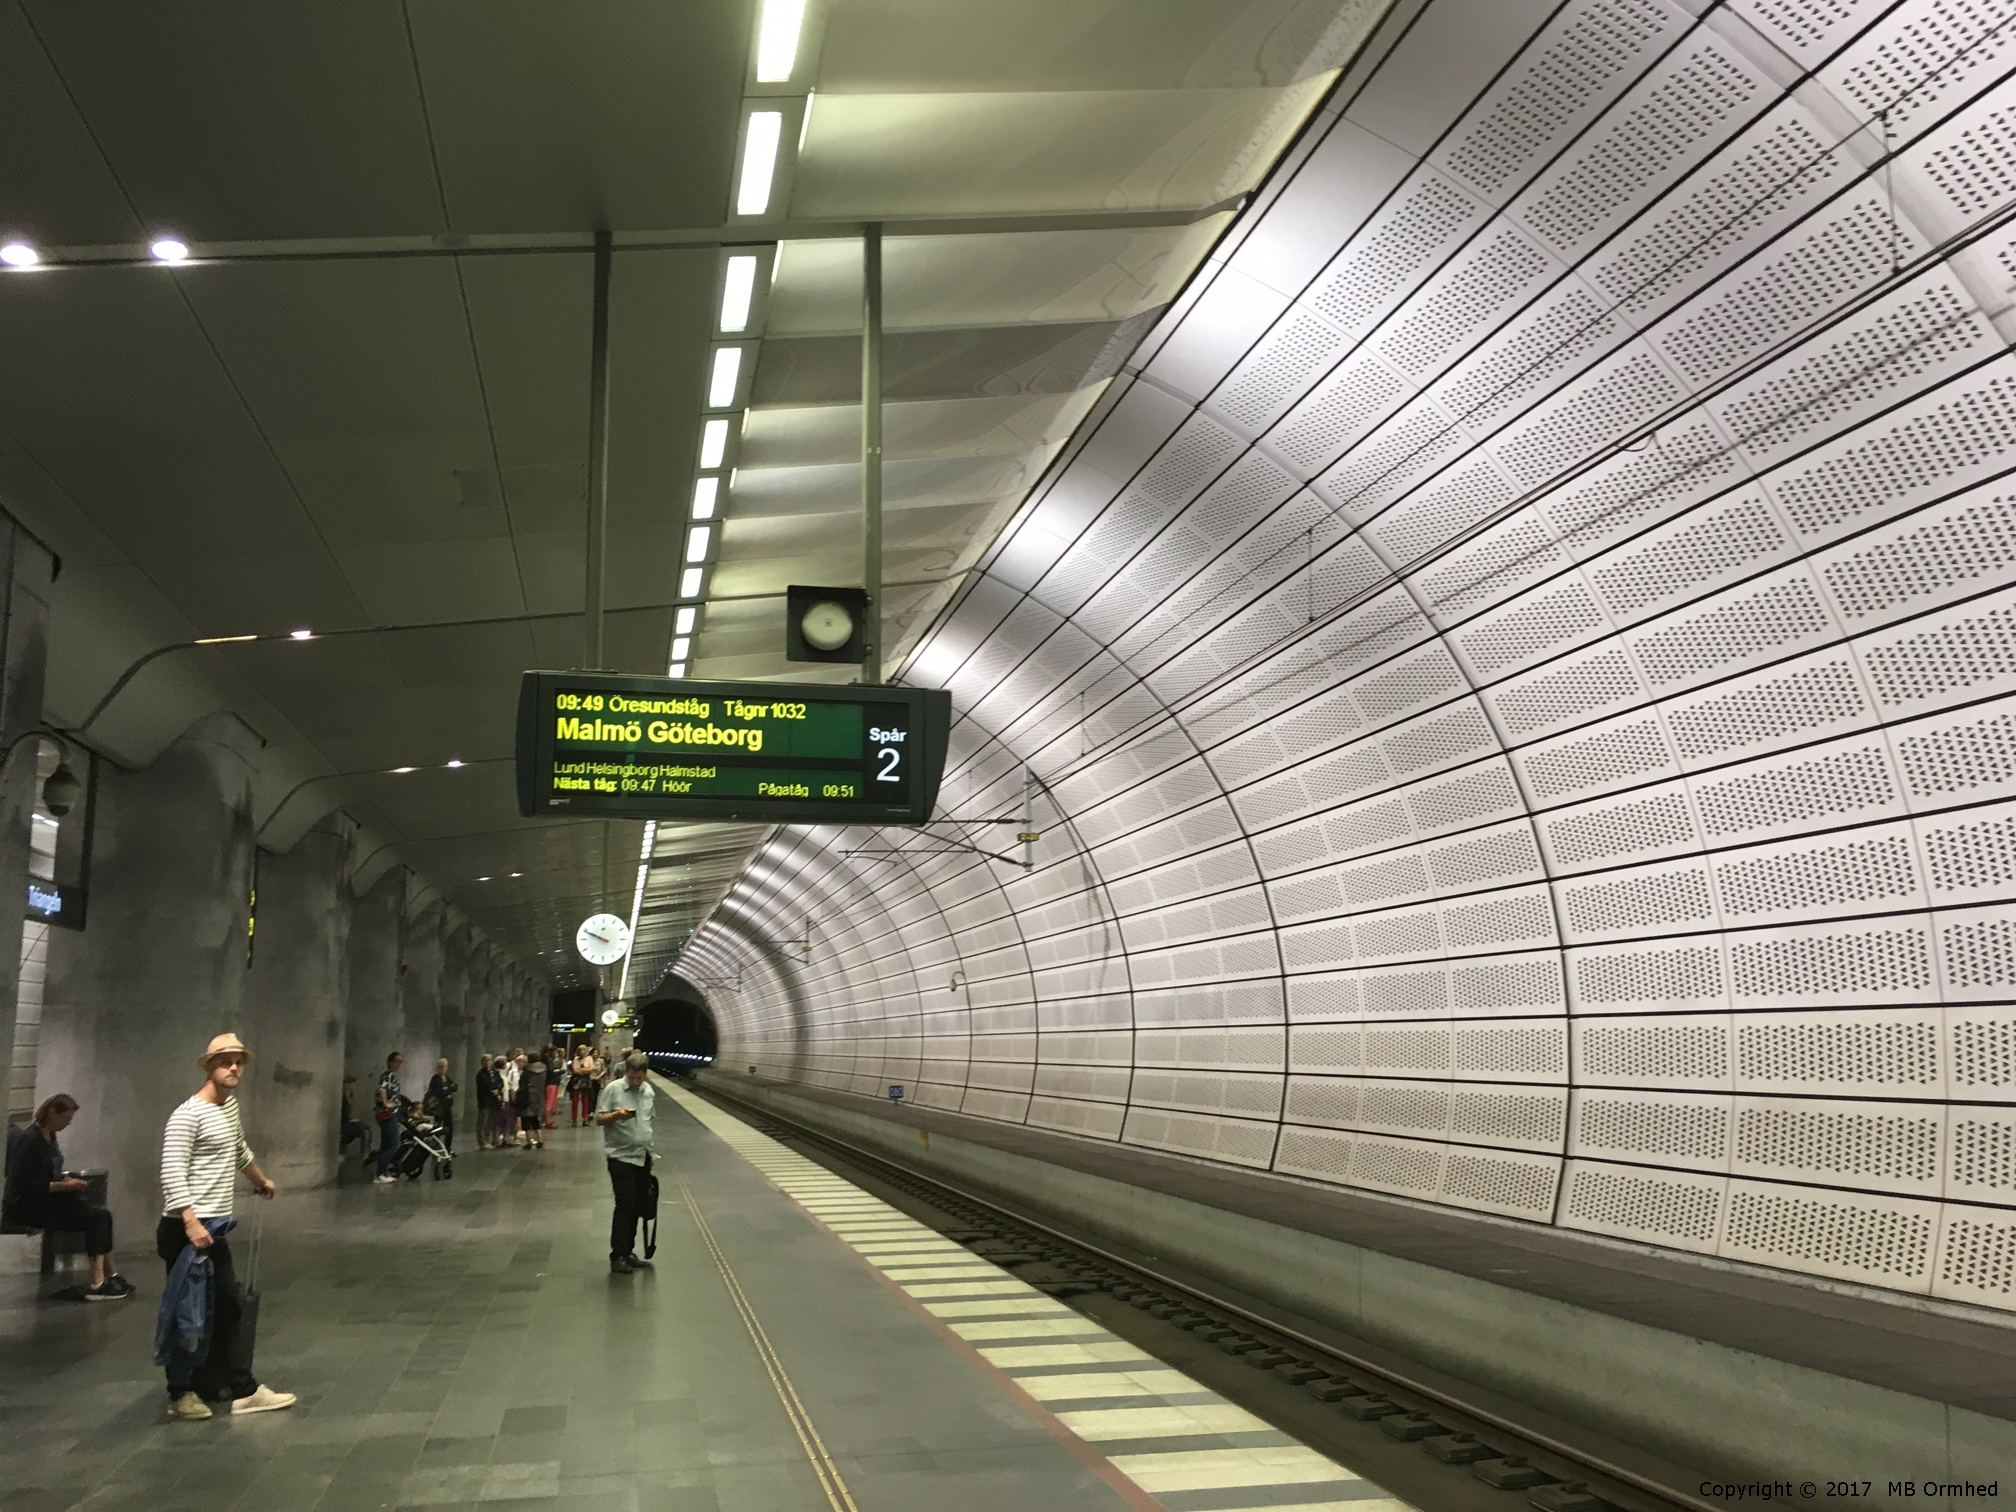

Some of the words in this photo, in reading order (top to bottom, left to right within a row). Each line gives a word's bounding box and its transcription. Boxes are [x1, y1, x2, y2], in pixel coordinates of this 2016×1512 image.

[556, 694, 604, 711] 09:49
[609, 694, 710, 718] Öresundståg
[724, 700, 769, 720] Tågnr
[770, 702, 806, 719] 1032
[556, 717, 642, 742] Malmö
[647, 720, 763, 752] Göteborg
[869, 727, 907, 744] Spår
[554, 761, 585, 774] Lund
[586, 762, 658, 777] Helsingborg
[659, 764, 716, 778] Halmstad
[876, 748, 900, 782] 2
[553, 777, 590, 790] Nästa
[621, 779, 656, 792] 09:47
[758, 782, 809, 797] Pågatåg
[823, 785, 854, 797] 09:51
